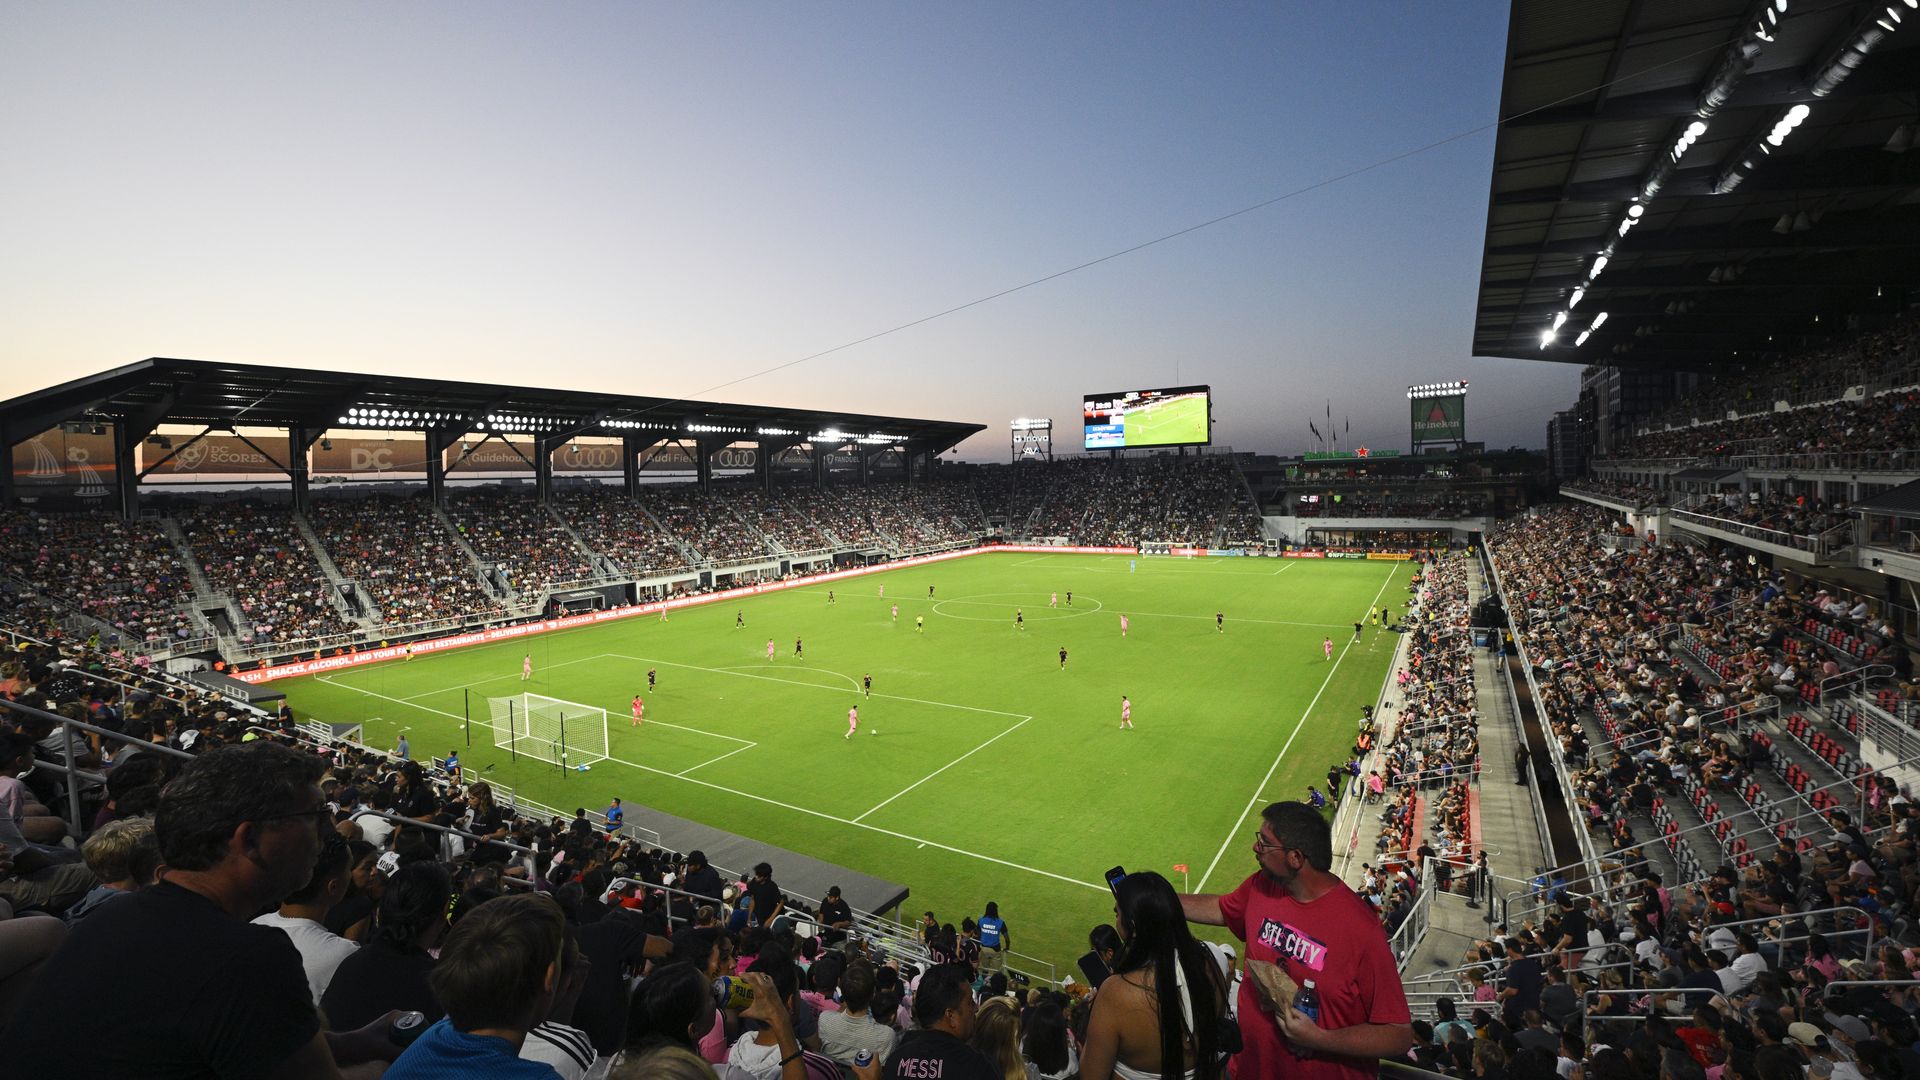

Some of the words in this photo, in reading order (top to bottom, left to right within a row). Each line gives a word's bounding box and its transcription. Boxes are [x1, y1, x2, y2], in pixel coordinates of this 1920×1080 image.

[1414, 420, 1459, 431] Heineken
[210, 453, 266, 463] SCORES
[351, 448, 393, 470] DC
[645, 453, 672, 463] Audi
[266, 664, 307, 679] SNACKS,
[308, 655, 352, 673] ALCOHOL,
[353, 651, 371, 662] AND
[372, 648, 396, 660] YOUR
[435, 633, 485, 650] RESTAURANTS
[491, 626, 527, 639] DELIVERED
[527, 623, 544, 633] WITH
[558, 616, 594, 627] DOORDASH
[1261, 921, 1283, 948] STL
[1286, 933, 1321, 965] CITY
[931, 947, 945, 964] 10
[896, 1057, 944, 1080] MESSI
